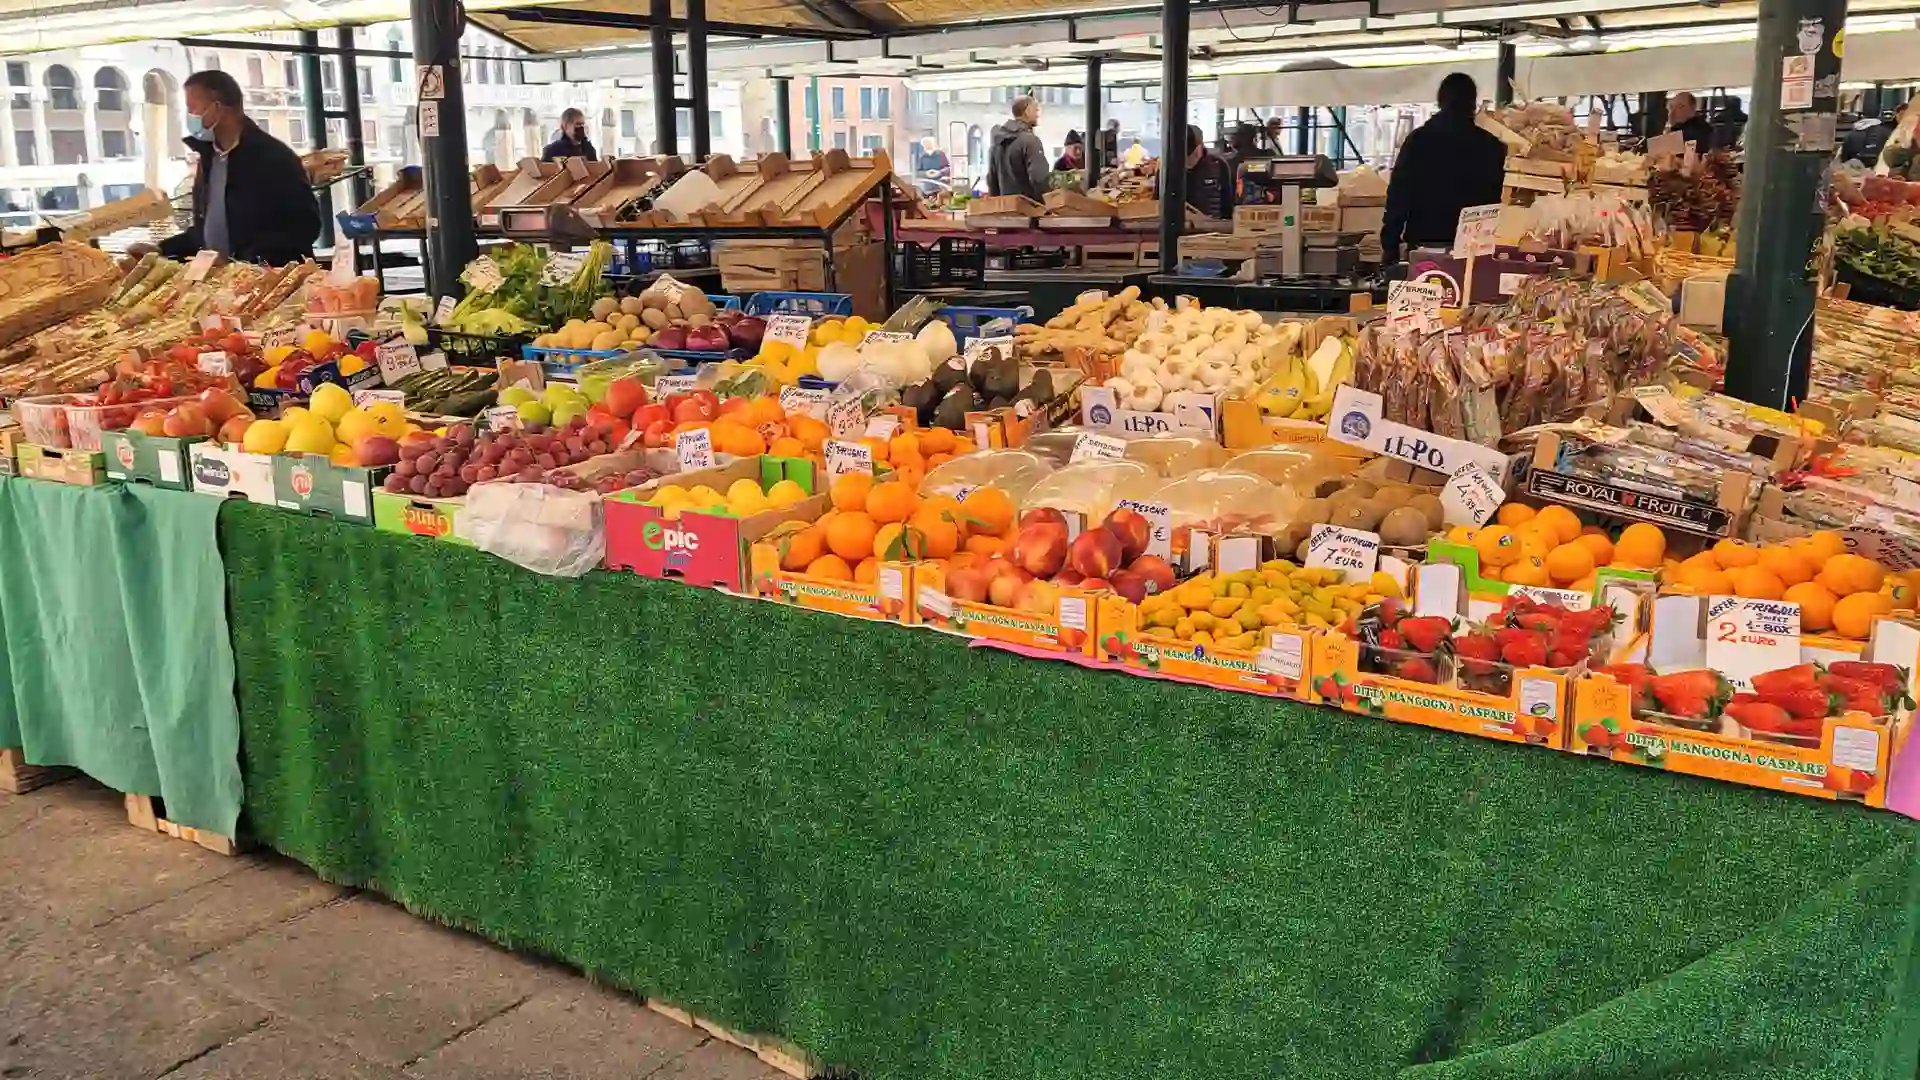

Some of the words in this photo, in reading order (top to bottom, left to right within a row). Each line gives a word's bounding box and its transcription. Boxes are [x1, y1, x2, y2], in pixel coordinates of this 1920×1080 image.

[1131, 502, 1168, 516] PESCHE
[1565, 480, 1619, 503] ROYAL
[1637, 496, 1692, 519] FRUIT
[642, 521, 700, 551] epic
[1310, 526, 1333, 548] OFFER
[1323, 547, 1339, 563] 7
[1335, 556, 1364, 569] EURO
[1709, 597, 1738, 617] OFFER
[1717, 621, 1737, 643] 2
[1741, 635, 1777, 647] EURO
[1353, 683, 1387, 701] DITTA
[1458, 703, 1516, 723] GASPARE
[1626, 732, 1667, 750] DITTA
[1755, 755, 1828, 776] GASPARE
